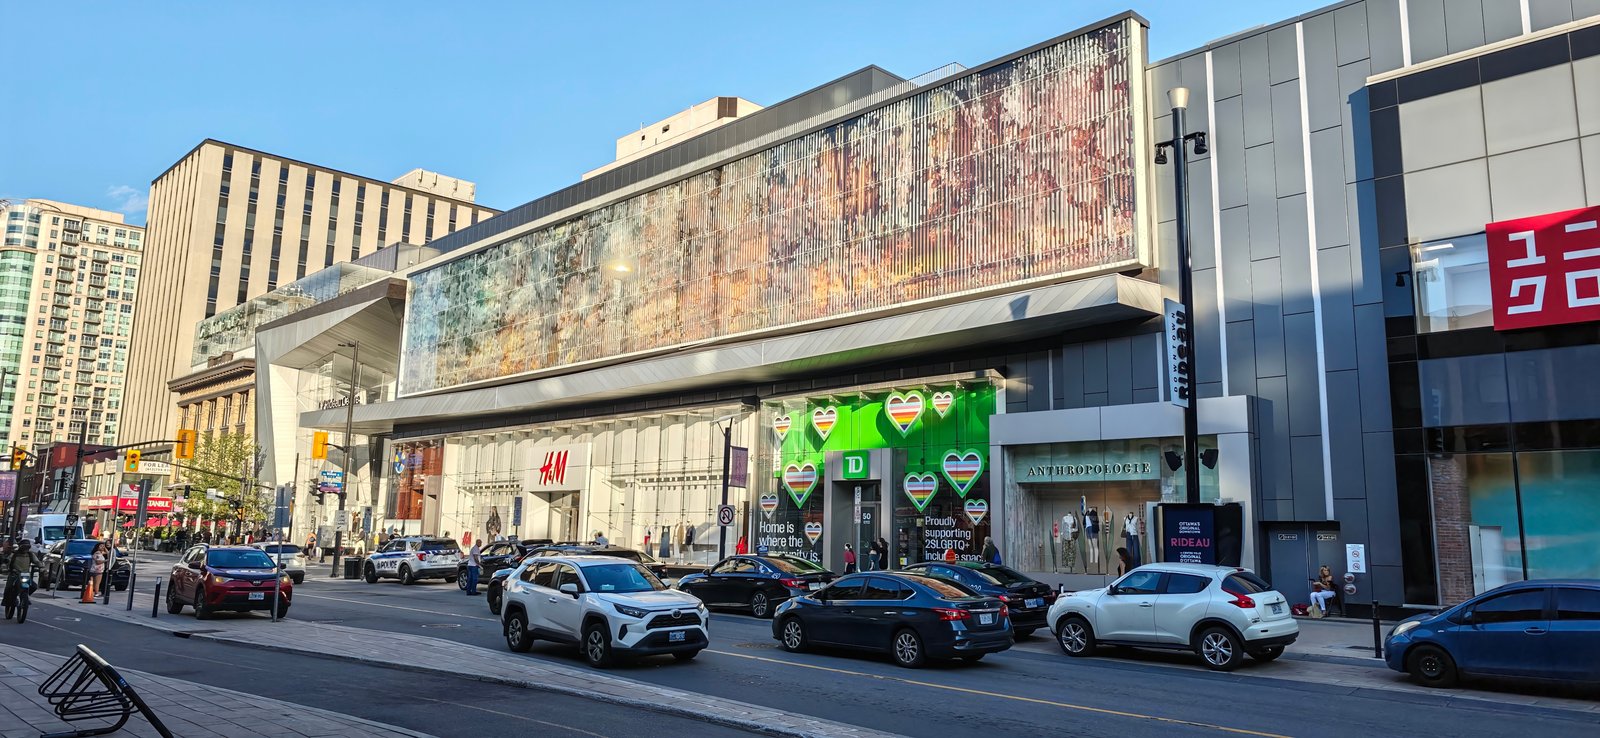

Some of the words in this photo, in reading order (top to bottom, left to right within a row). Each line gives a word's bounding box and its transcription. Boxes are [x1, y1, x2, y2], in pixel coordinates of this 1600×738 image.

[539, 450, 568, 486] H&M
[845, 456, 863, 473] TD
[1027, 462, 1151, 476] ANTHROPOLOGIE
[759, 521, 785, 533] Home
[786, 521, 795, 533] is
[925, 516, 957, 527] Proudly
[925, 529, 971, 540] supporting
[759, 535, 787, 547] where
[788, 535, 803, 547] the
[925, 540, 970, 551] 2SLGBTQ+
[1171, 538, 1210, 547] RIDEAU
[810, 549, 820, 562] is.
[925, 551, 960, 560] inclue
[381, 561, 398, 569] POLICE
